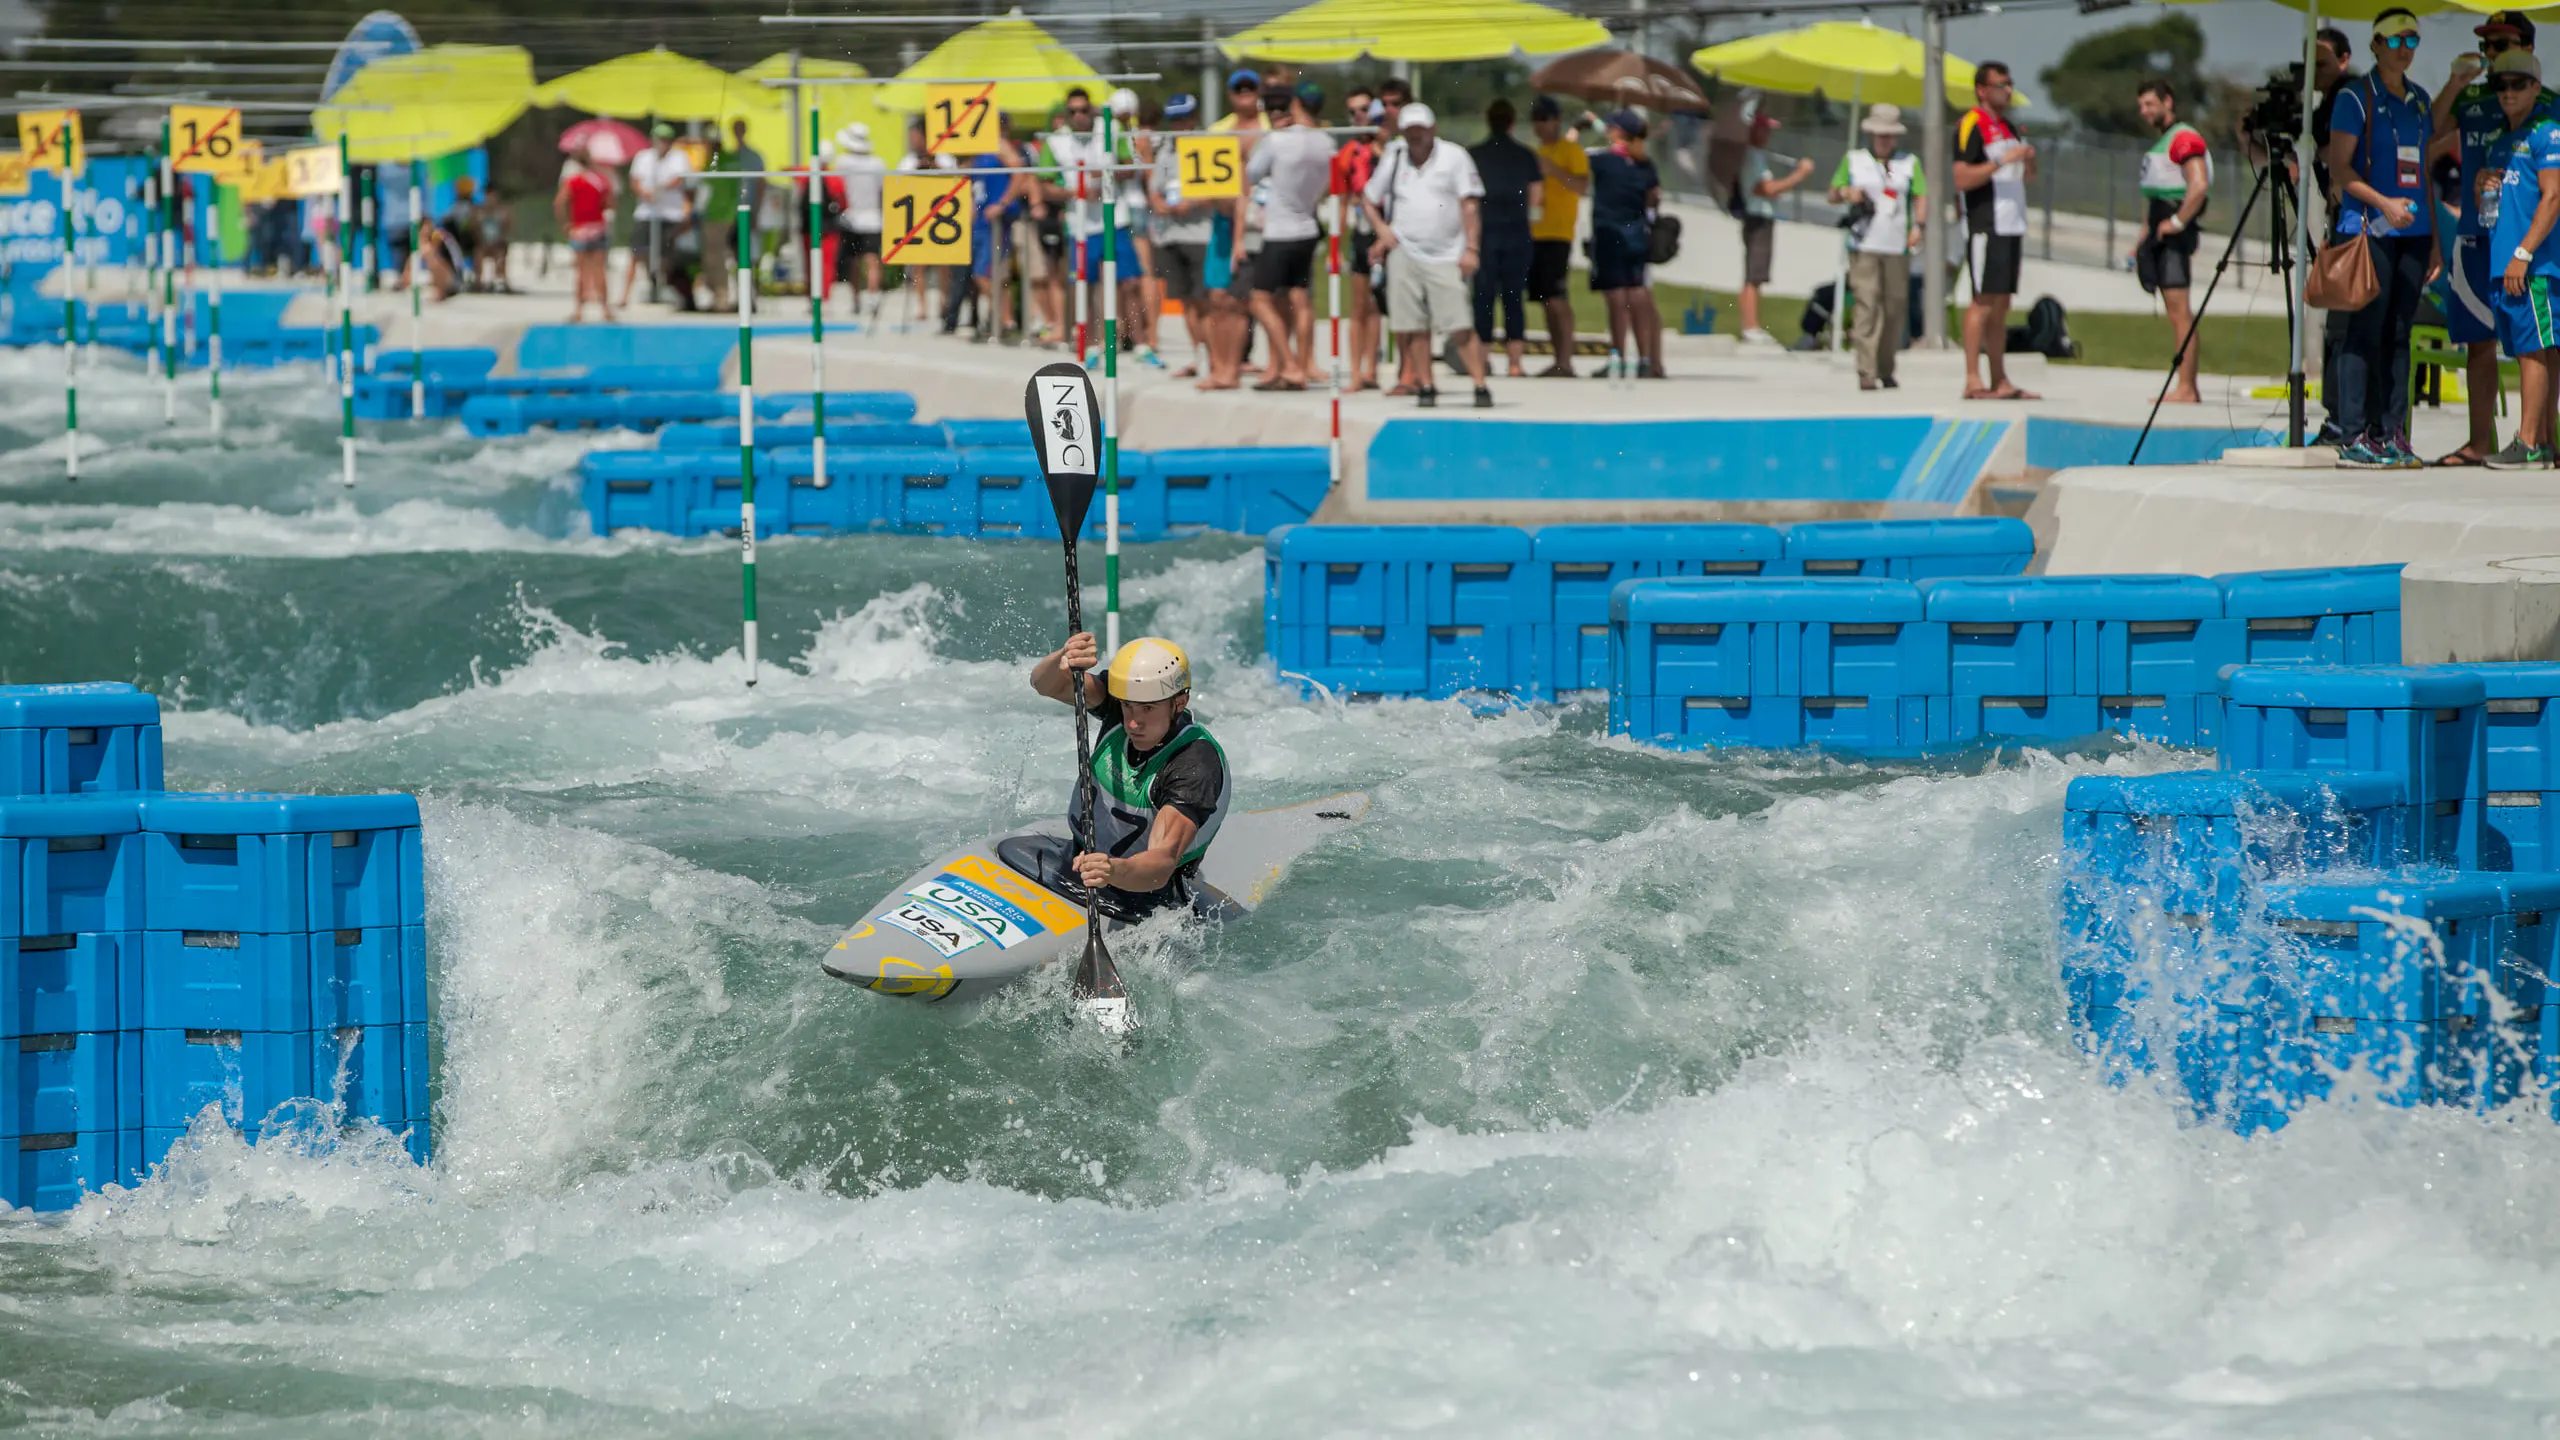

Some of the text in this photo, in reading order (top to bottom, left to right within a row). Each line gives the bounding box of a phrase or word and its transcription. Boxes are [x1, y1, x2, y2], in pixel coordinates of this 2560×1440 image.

[935, 98, 990, 139] 17
[26, 124, 73, 155] 14
[180, 119, 232, 158] 16
[1185, 148, 1234, 185] 15
[892, 194, 962, 246] 18
[742, 517, 751, 551] 18
[929, 887, 1007, 936] USA
[954, 881, 1004, 907] Aquece
[899, 909, 960, 948] USA
